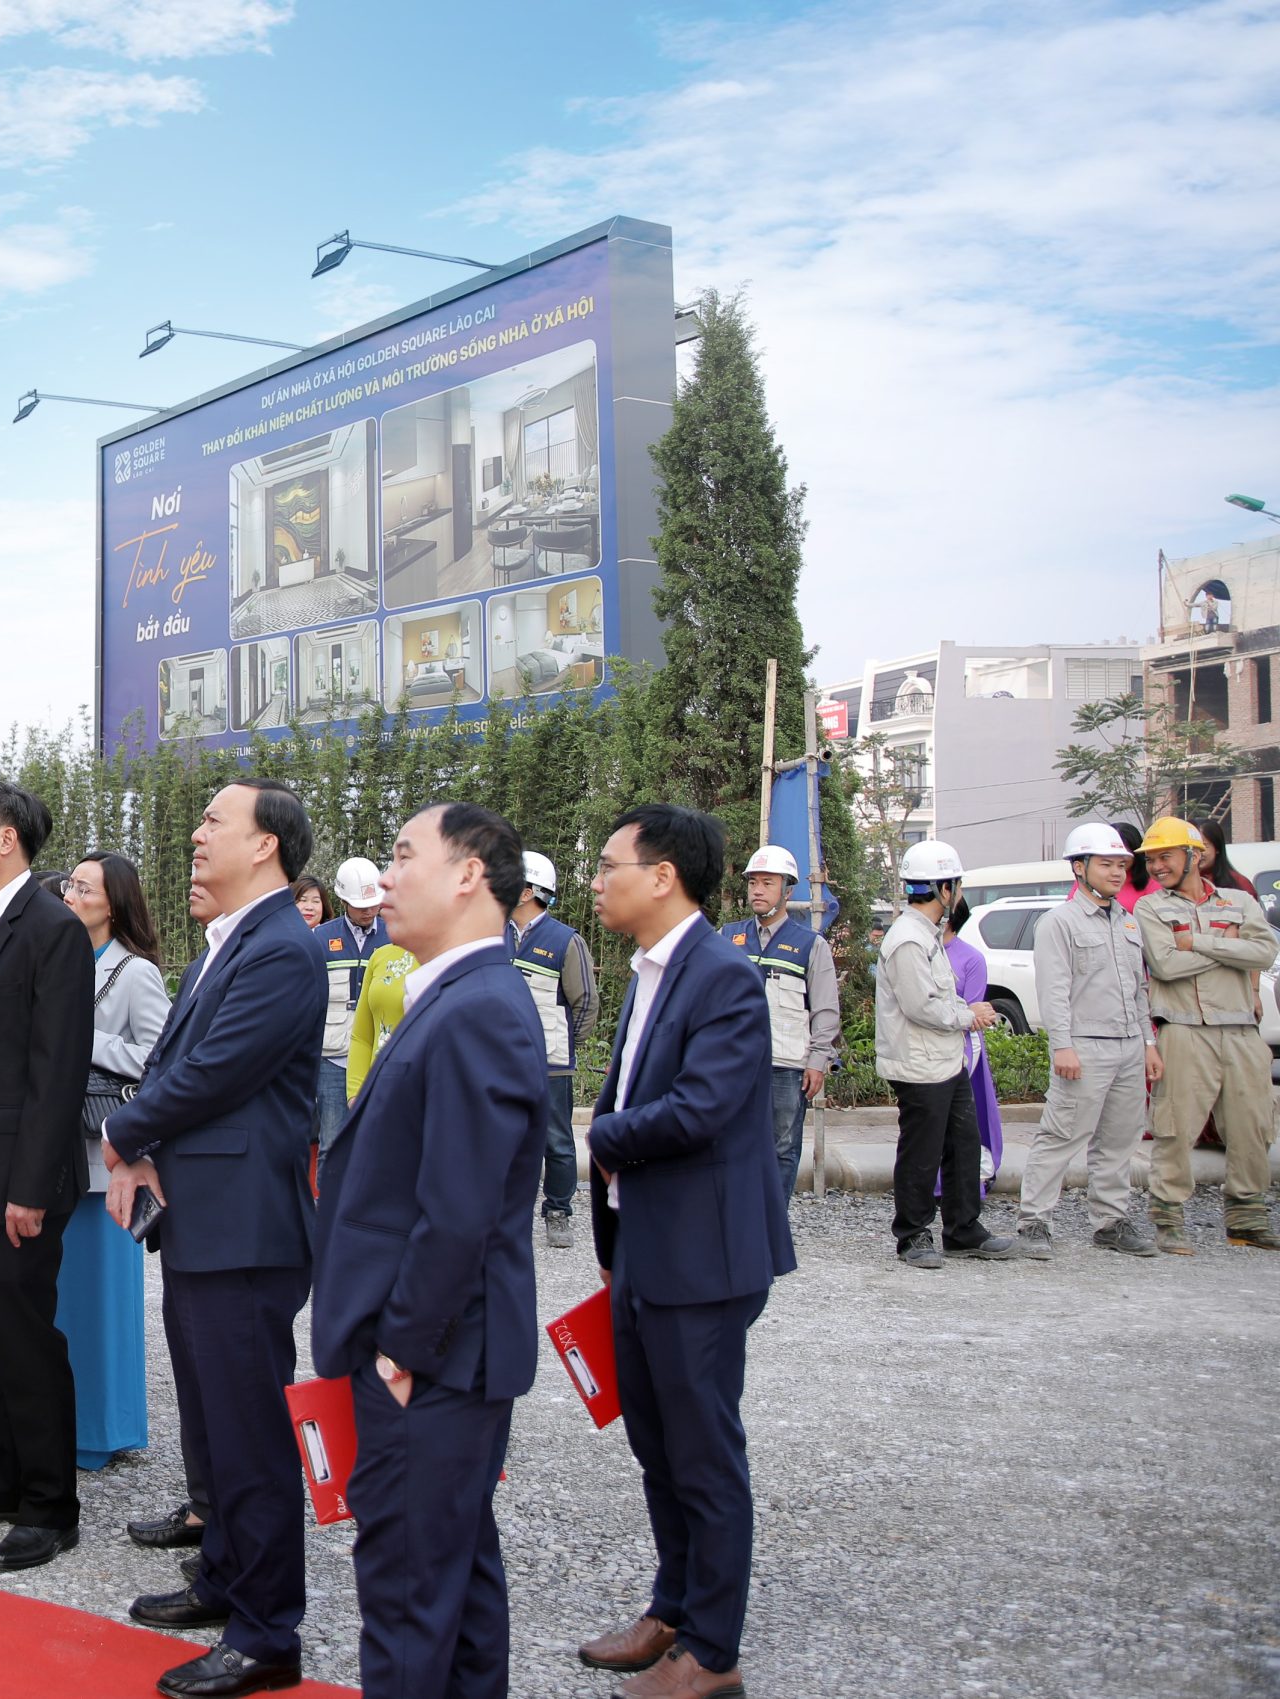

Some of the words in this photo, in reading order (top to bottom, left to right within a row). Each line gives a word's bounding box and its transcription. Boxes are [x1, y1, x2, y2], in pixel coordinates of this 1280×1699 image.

[201, 437, 225, 457] THAY
[226, 426, 244, 448] ĐỔI
[244, 419, 269, 441] KHÁI
[269, 408, 295, 432] NIỆM
[295, 397, 324, 424] CHẤT
[324, 385, 364, 412] LƯỢNG
[363, 378, 381, 398] VÀ
[381, 369, 404, 391] MÔI
[405, 348, 459, 380] TRƯỜNG
[459, 334, 498, 362] SỐNG
[499, 319, 530, 347] NHÀ
[531, 312, 544, 334] Ở
[544, 303, 566, 330] XÃ
[566, 294, 596, 322] HỘI
[261, 394, 277, 410] DỰ
[275, 389, 290, 403] ÁN
[291, 375, 312, 398] NHÀ
[313, 371, 324, 389] Ở
[322, 371, 336, 386] XÃ
[337, 360, 356, 380] HỘI
[357, 343, 400, 372] GOLDEN
[401, 324, 448, 354] SQUARE
[449, 314, 473, 336] LÀO
[474, 304, 496, 326] CAI
[132, 436, 166, 459] GOLDEN
[132, 449, 166, 471] SQUARE
[150, 484, 183, 521] Nơi
[112, 522, 179, 609] Tình
[171, 539, 217, 605] yêu
[136, 613, 160, 643] bắt
[162, 607, 191, 637] đầu
